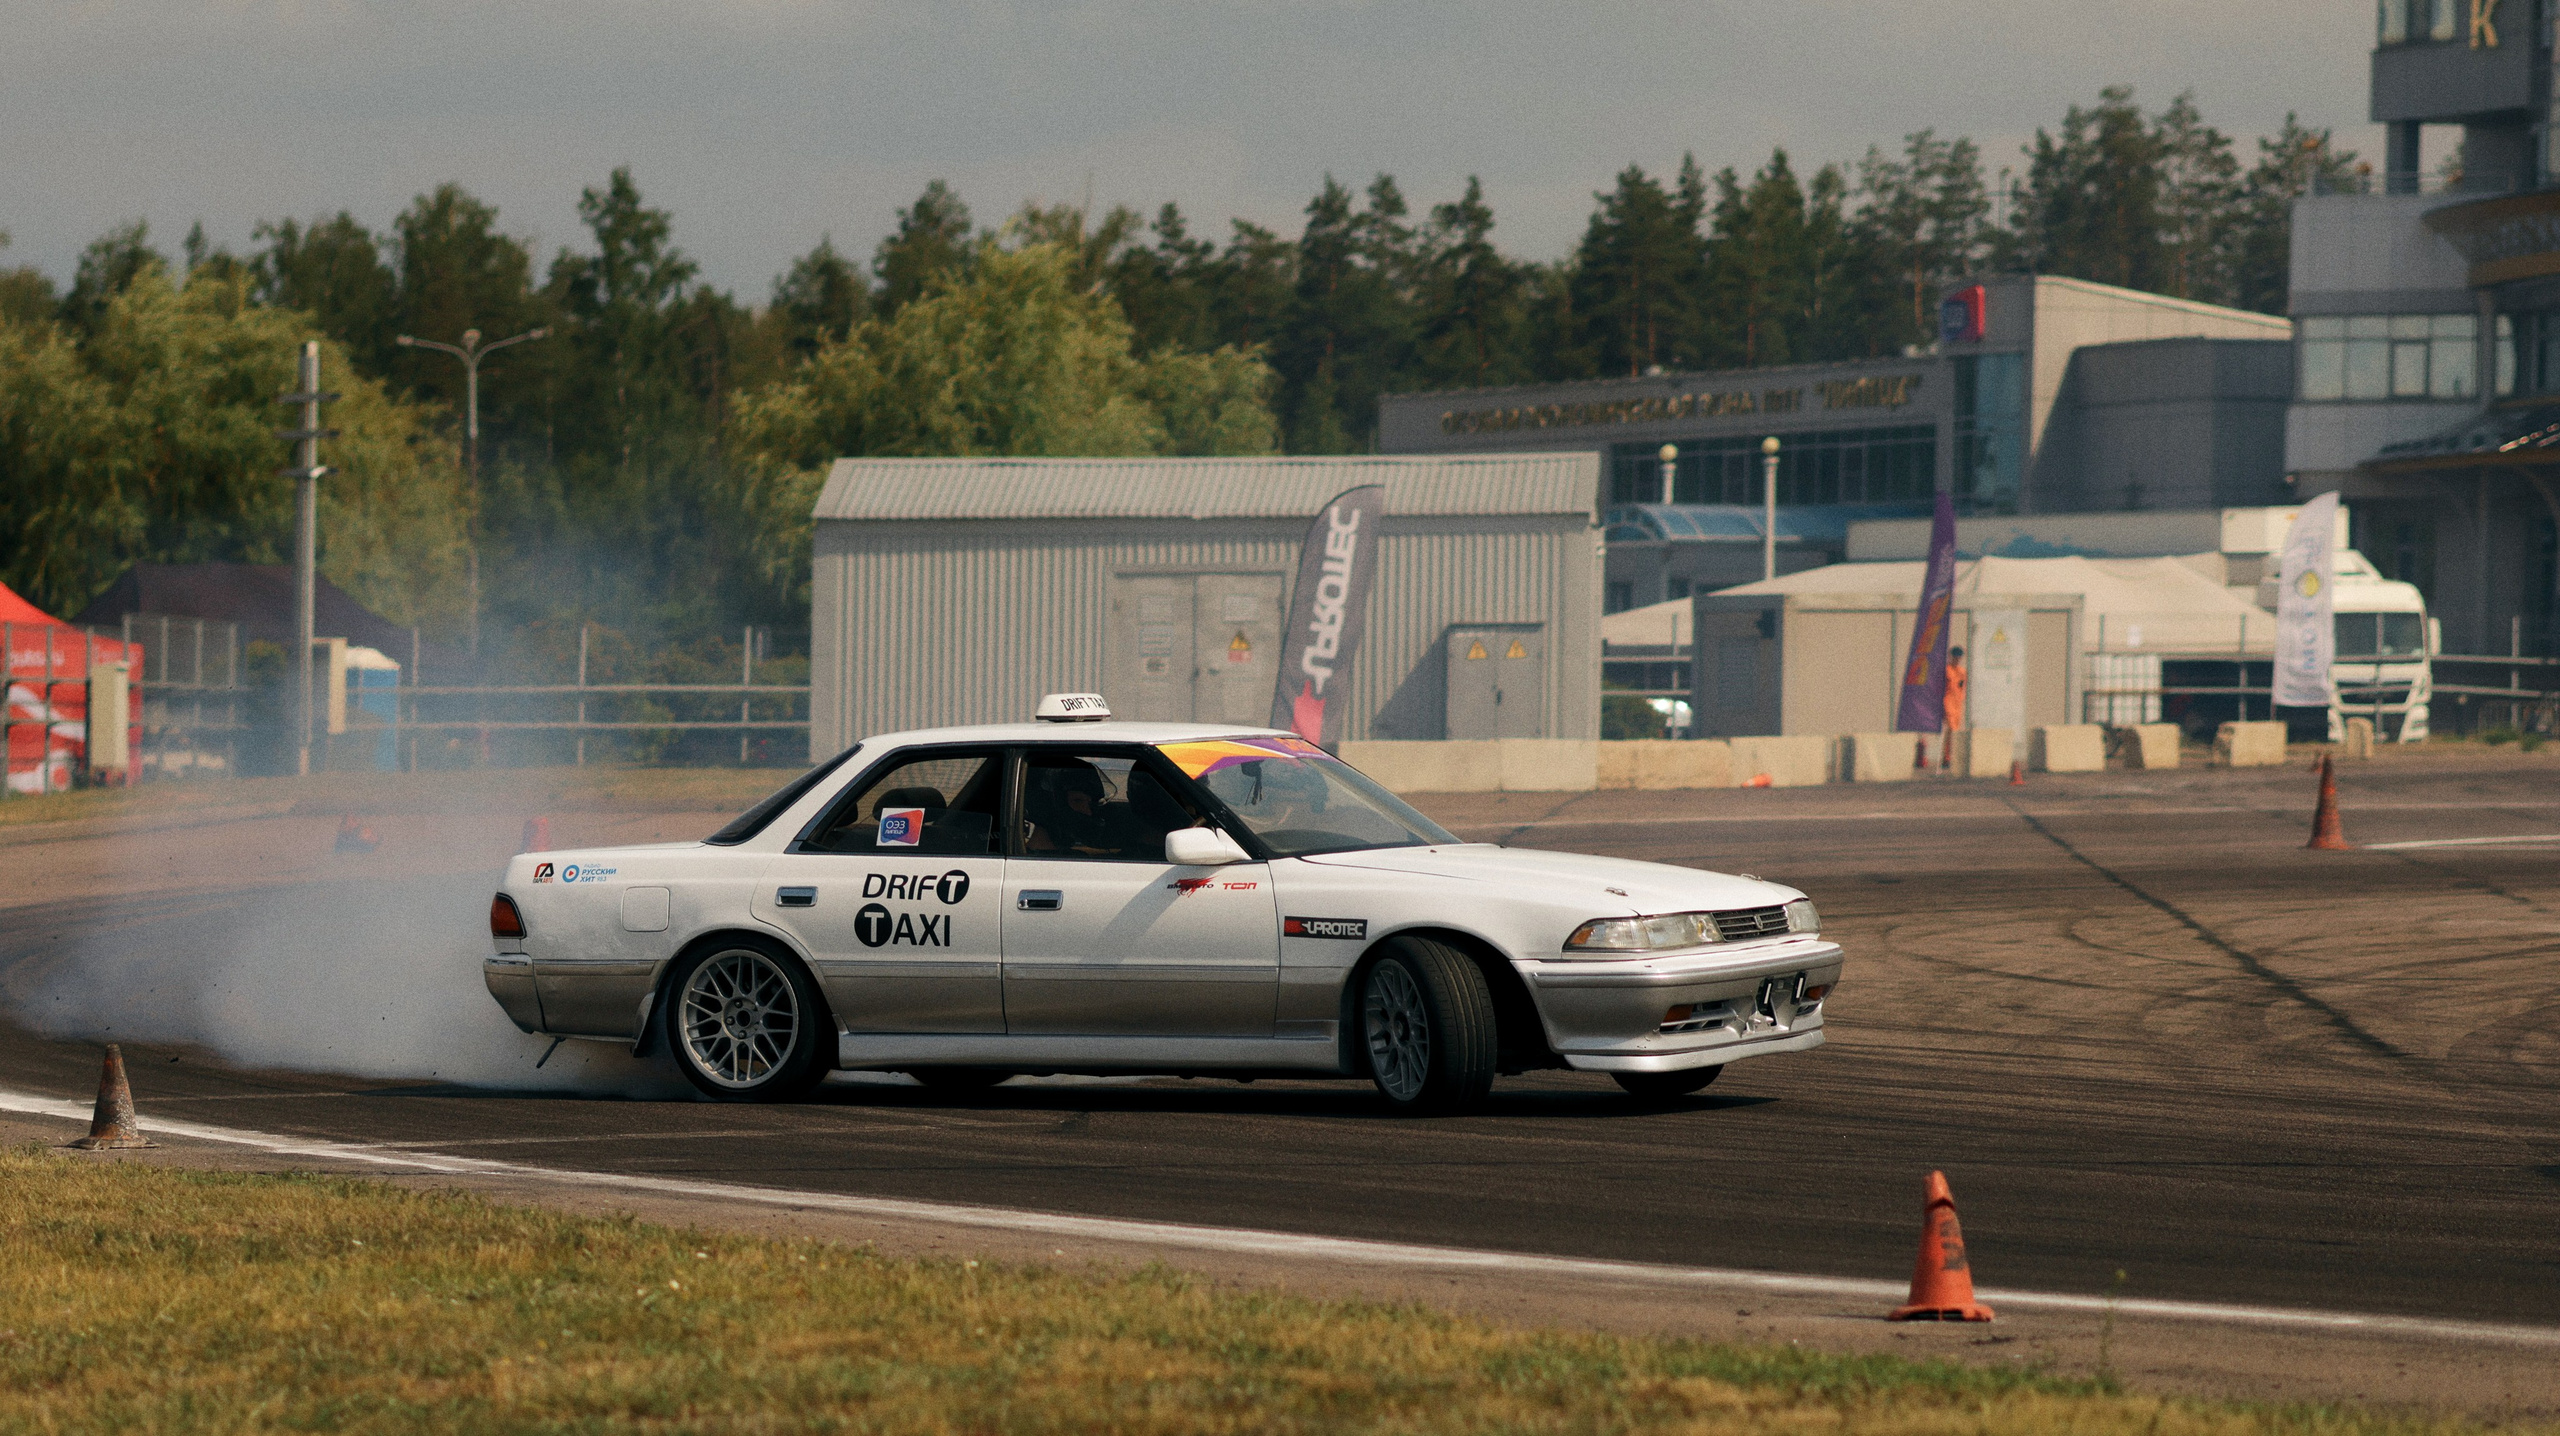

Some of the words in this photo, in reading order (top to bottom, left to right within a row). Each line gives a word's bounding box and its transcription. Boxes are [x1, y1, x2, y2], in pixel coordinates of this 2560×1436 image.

[1060, 697, 1090, 711] DRIFT
[862, 871, 968, 904] DRIFT
[856, 905, 950, 947] TAXI
